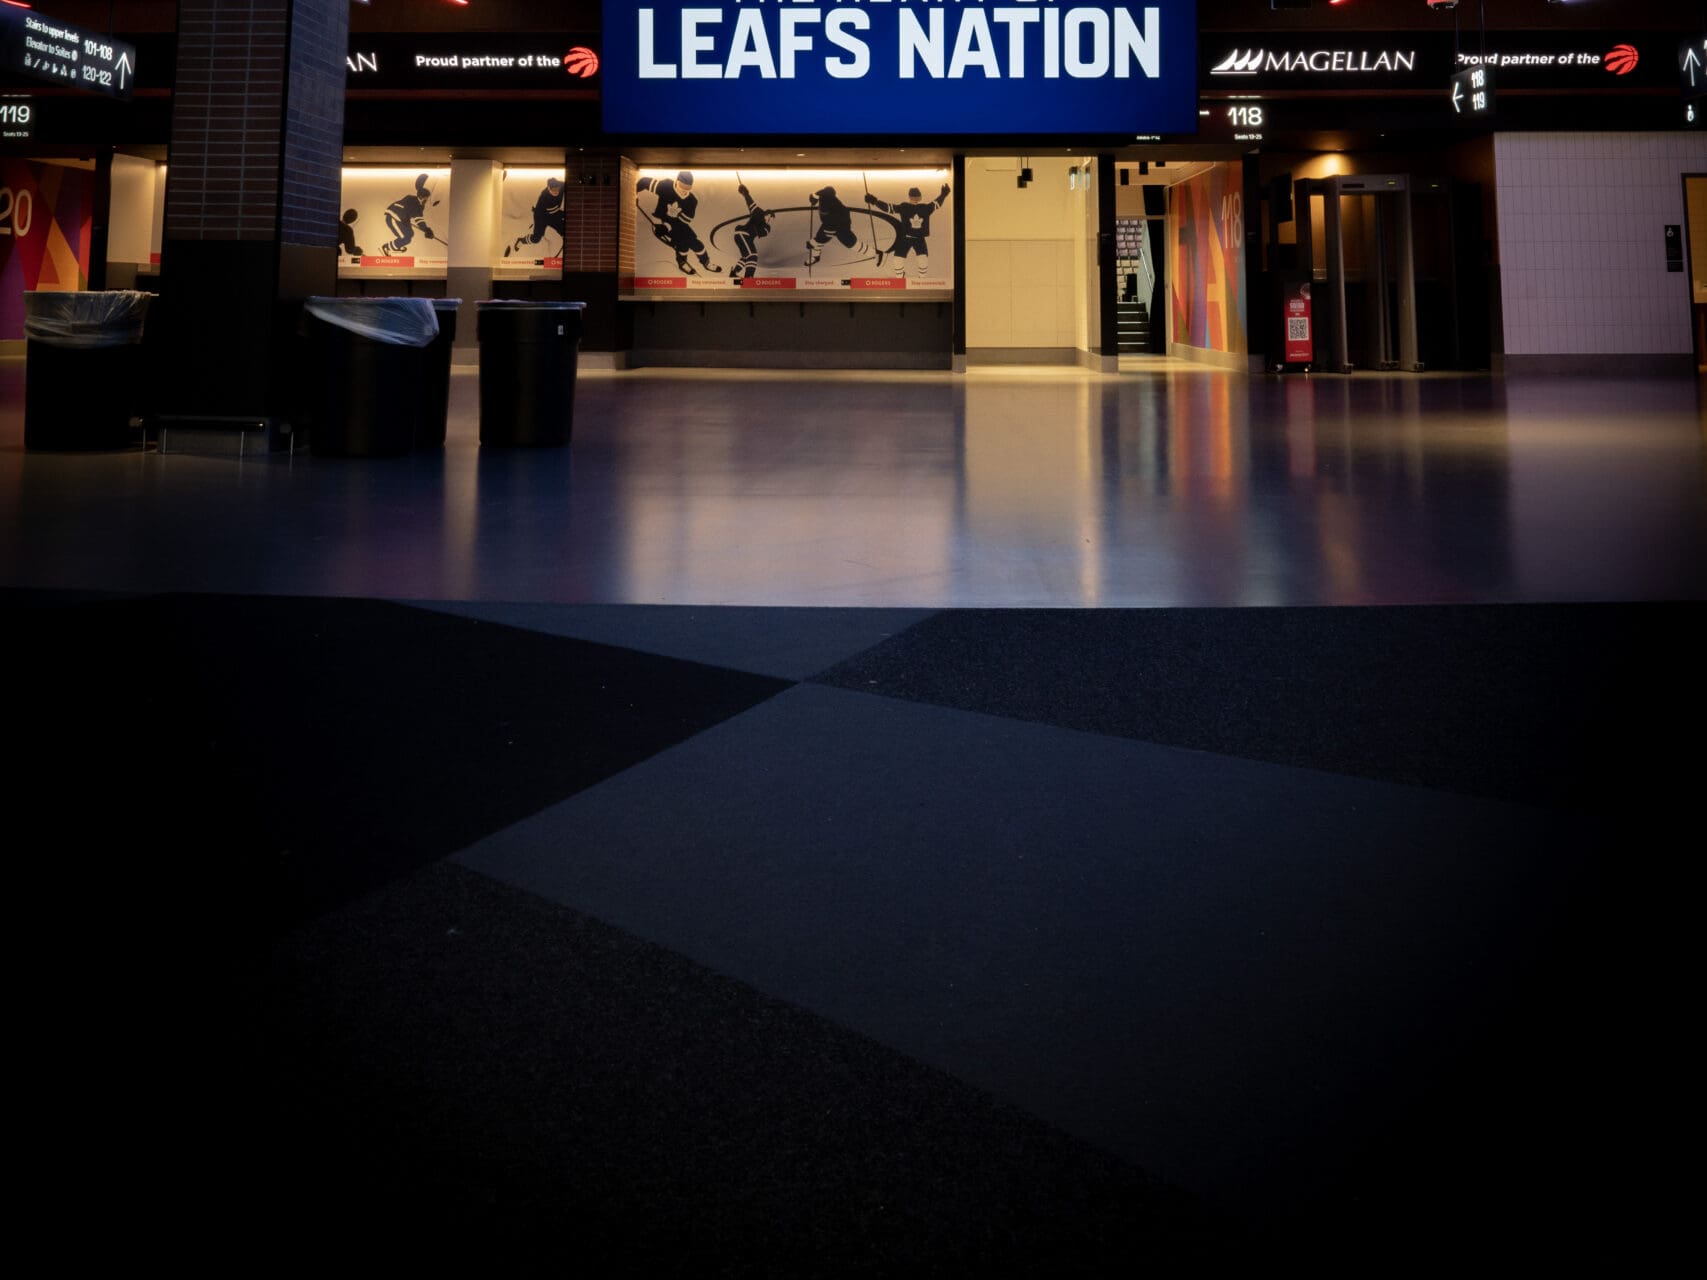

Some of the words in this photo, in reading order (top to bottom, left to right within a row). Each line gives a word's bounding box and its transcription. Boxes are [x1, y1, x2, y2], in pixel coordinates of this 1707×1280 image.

[84, 39, 113, 61] 101-108
[638, 7, 871, 79] LEAFS
[898, 7, 1160, 79] NATION
[415, 55, 459, 68] Proud
[462, 55, 515, 70] partner
[517, 54, 534, 68] of
[535, 55, 561, 68] the
[1264, 50, 1415, 72] MAGELLAN
[1500, 53, 1555, 67] partner
[1557, 53, 1574, 65] of
[1576, 53, 1601, 65] the
[82, 65, 112, 86] 120-122
[1471, 68, 1485, 89] 118
[1472, 91, 1486, 111] 119
[1227, 106, 1263, 126] 118
